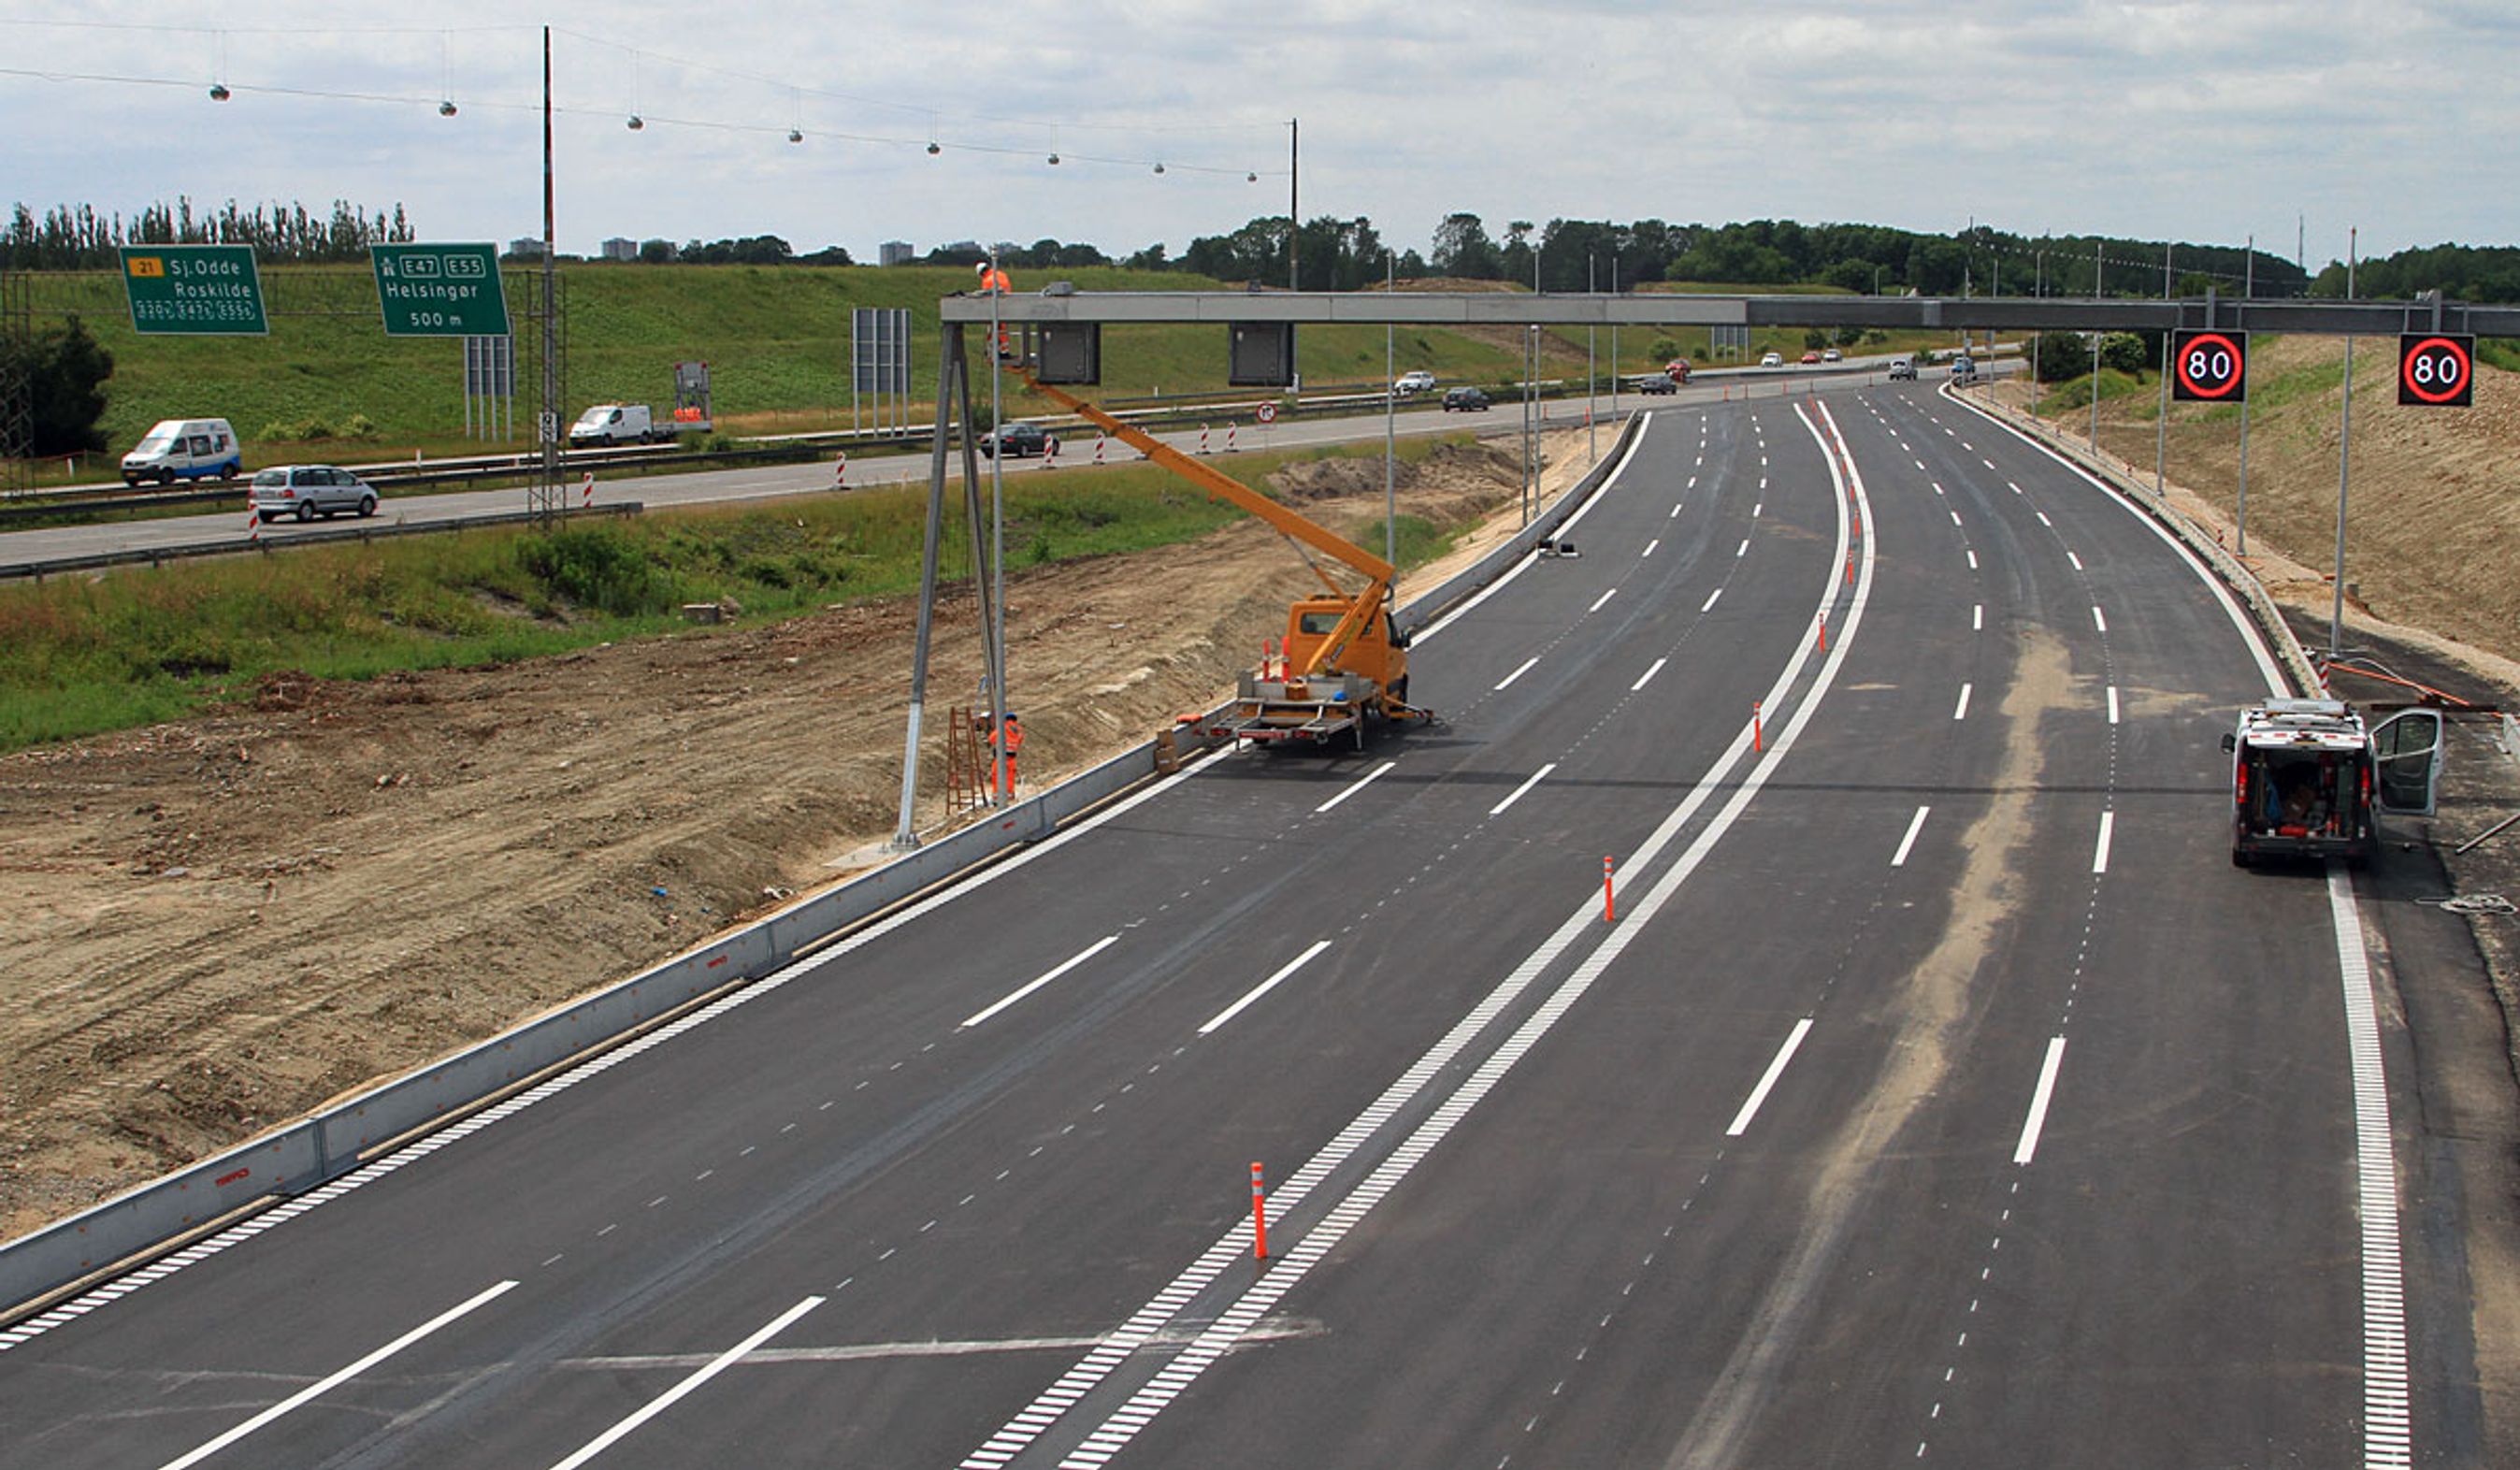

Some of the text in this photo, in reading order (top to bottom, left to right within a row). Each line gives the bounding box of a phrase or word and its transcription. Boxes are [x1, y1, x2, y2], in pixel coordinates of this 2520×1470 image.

[405, 260, 481, 273] E47 E55
[174, 282, 252, 297] Roskilde
[385, 282, 478, 301] Helsingør
[410, 312, 463, 326] 500 m
[2188, 351, 2230, 380] 80
[2414, 354, 2457, 383] 80
